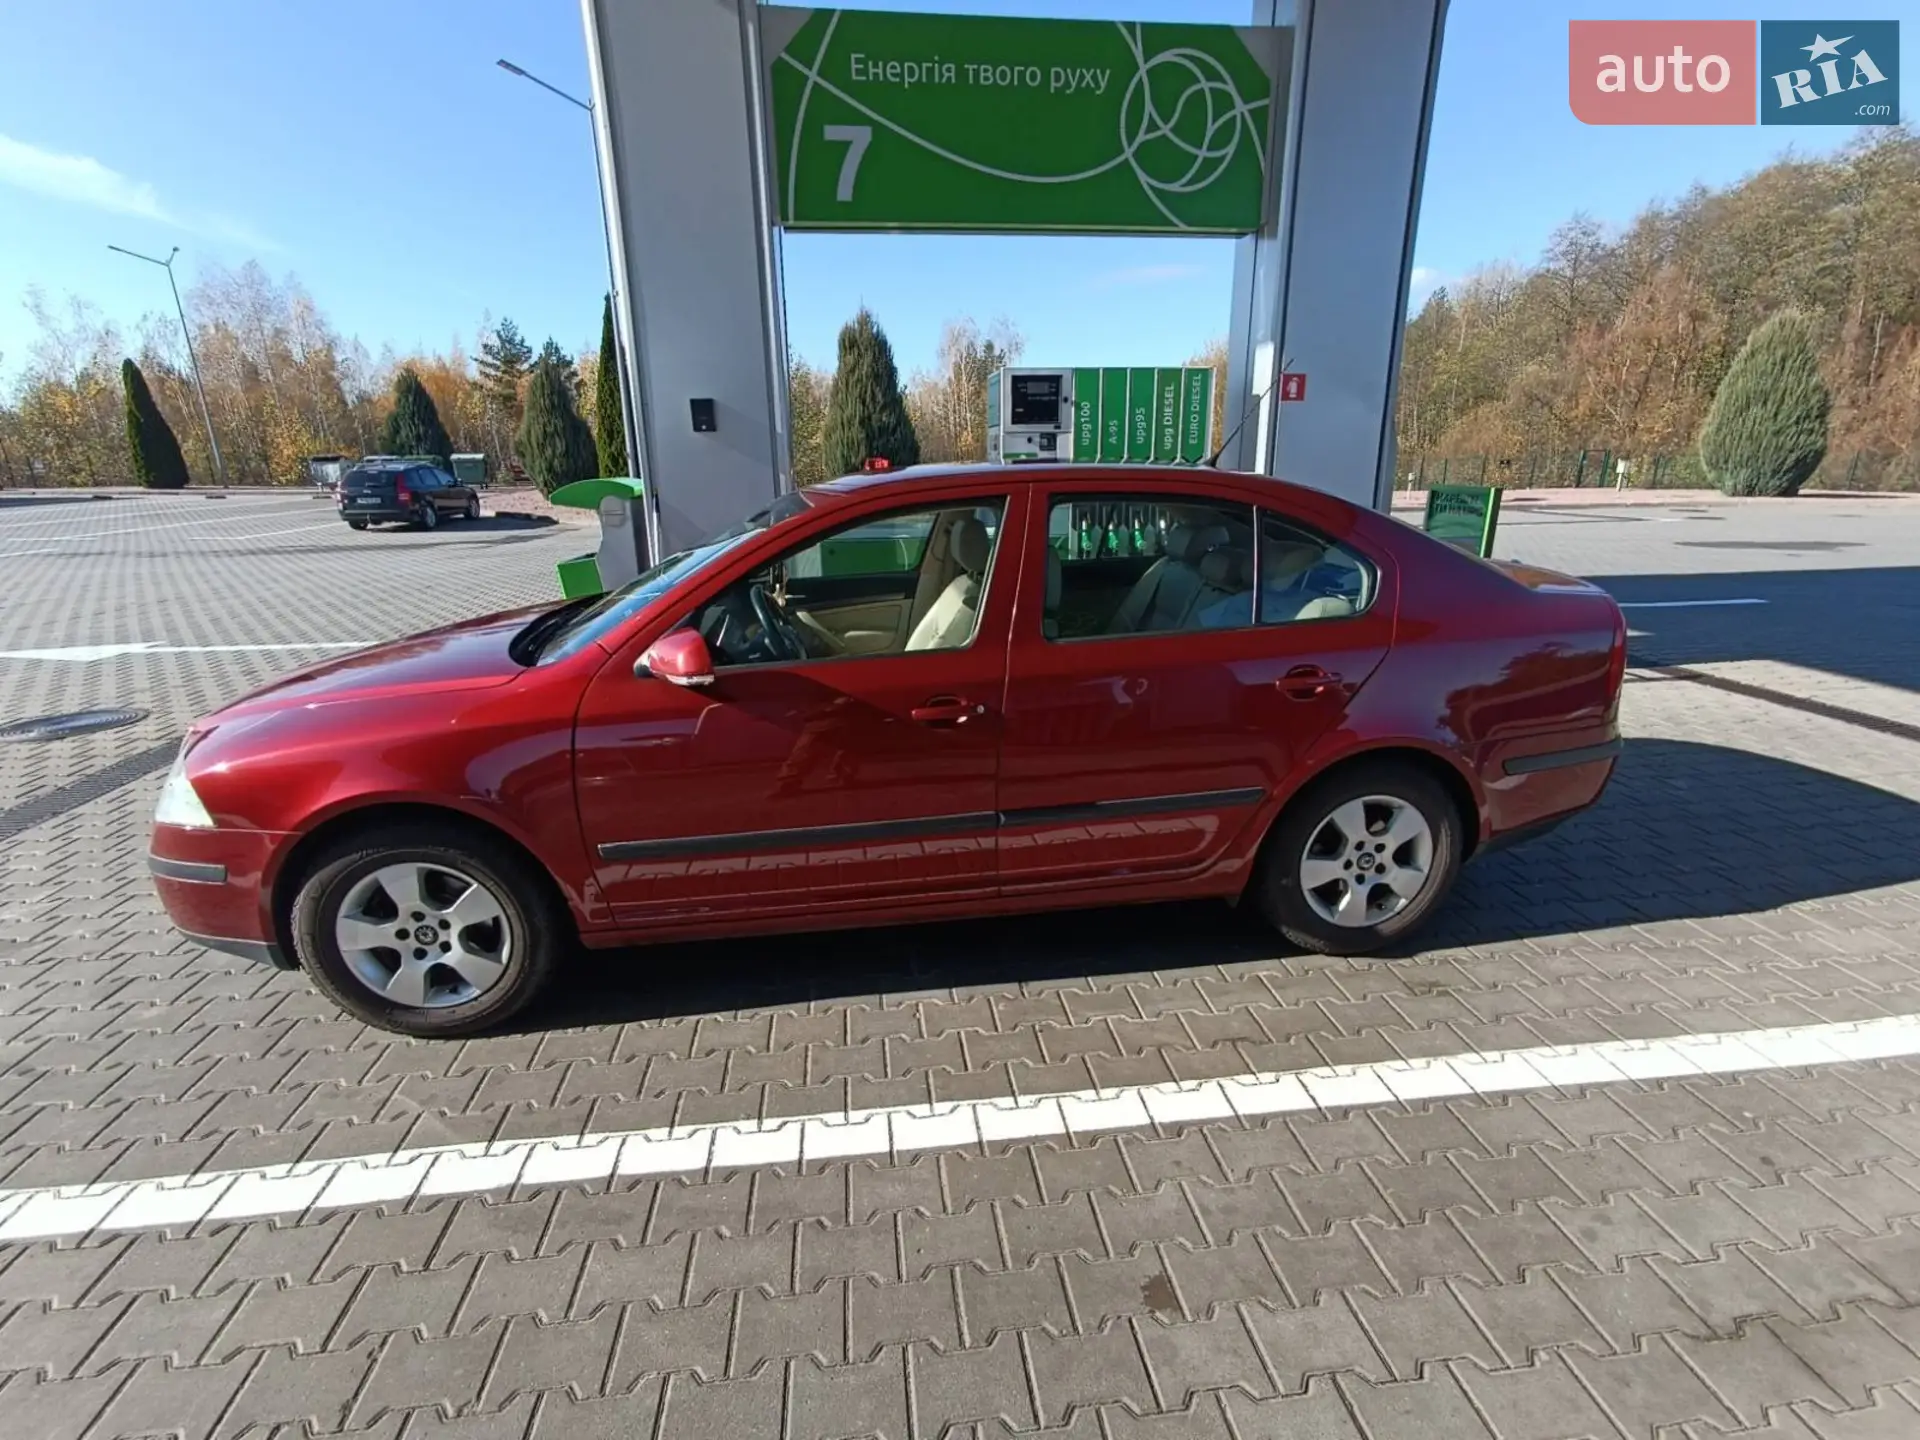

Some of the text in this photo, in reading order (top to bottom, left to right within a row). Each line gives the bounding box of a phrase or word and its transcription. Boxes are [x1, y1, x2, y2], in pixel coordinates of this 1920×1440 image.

[850, 53, 1111, 95] Енергія твого руху
[823, 124, 873, 202] 7
[1080, 401, 1092, 446] upg100
[1135, 407, 1146, 444] upg95
[1164, 384, 1174, 450] upg DIESEL
[1188, 374, 1202, 445] EURO DIESEL
